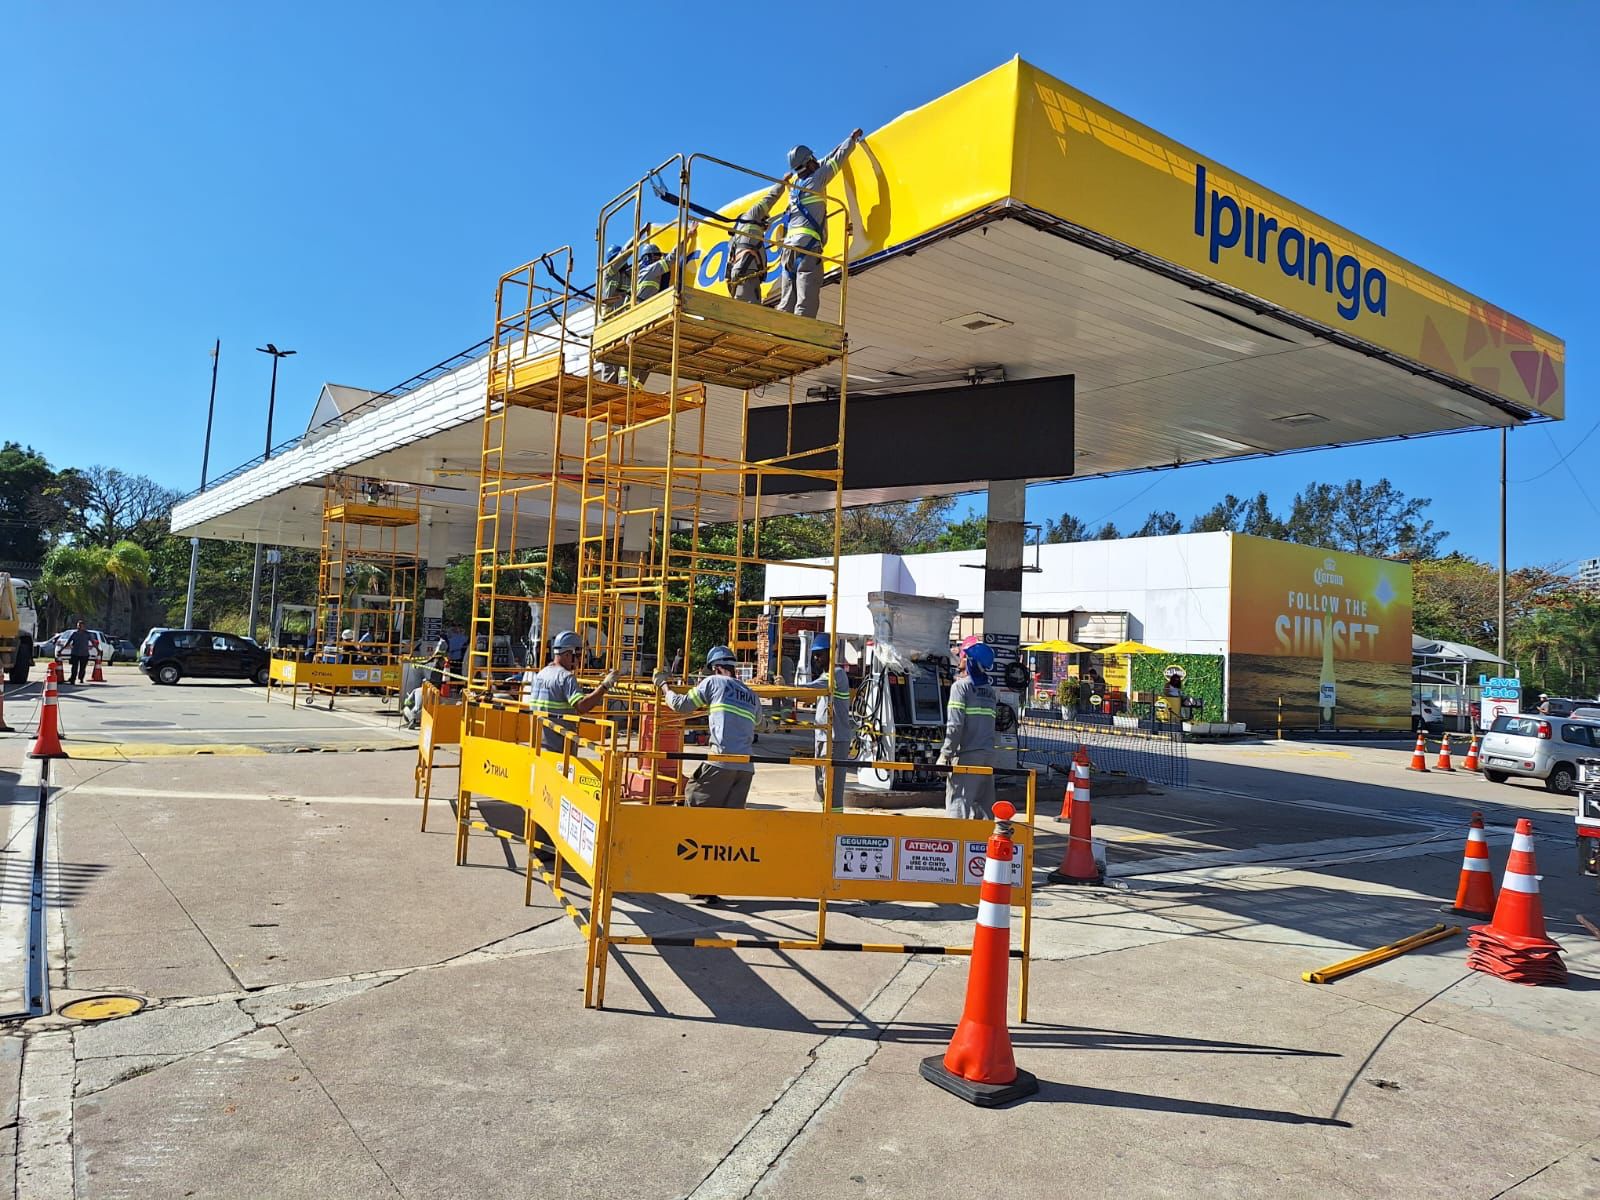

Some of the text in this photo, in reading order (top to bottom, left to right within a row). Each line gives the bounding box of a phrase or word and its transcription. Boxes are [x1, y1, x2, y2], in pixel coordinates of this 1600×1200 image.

[1194, 163, 1387, 321] Ipiranga
[1314, 568, 1344, 587] Corona
[1288, 591, 1368, 617] FOLLOW THE
[1275, 614, 1380, 657] SUNSET
[1480, 674, 1520, 688] Lava
[735, 688, 757, 706] TRIAL
[1482, 687, 1518, 698] Jato
[491, 764, 509, 778] TRIAL
[841, 838, 888, 847] SEGURANÇA
[908, 841, 950, 852] ATENÇÃO
[701, 845, 760, 862] TRIAL
